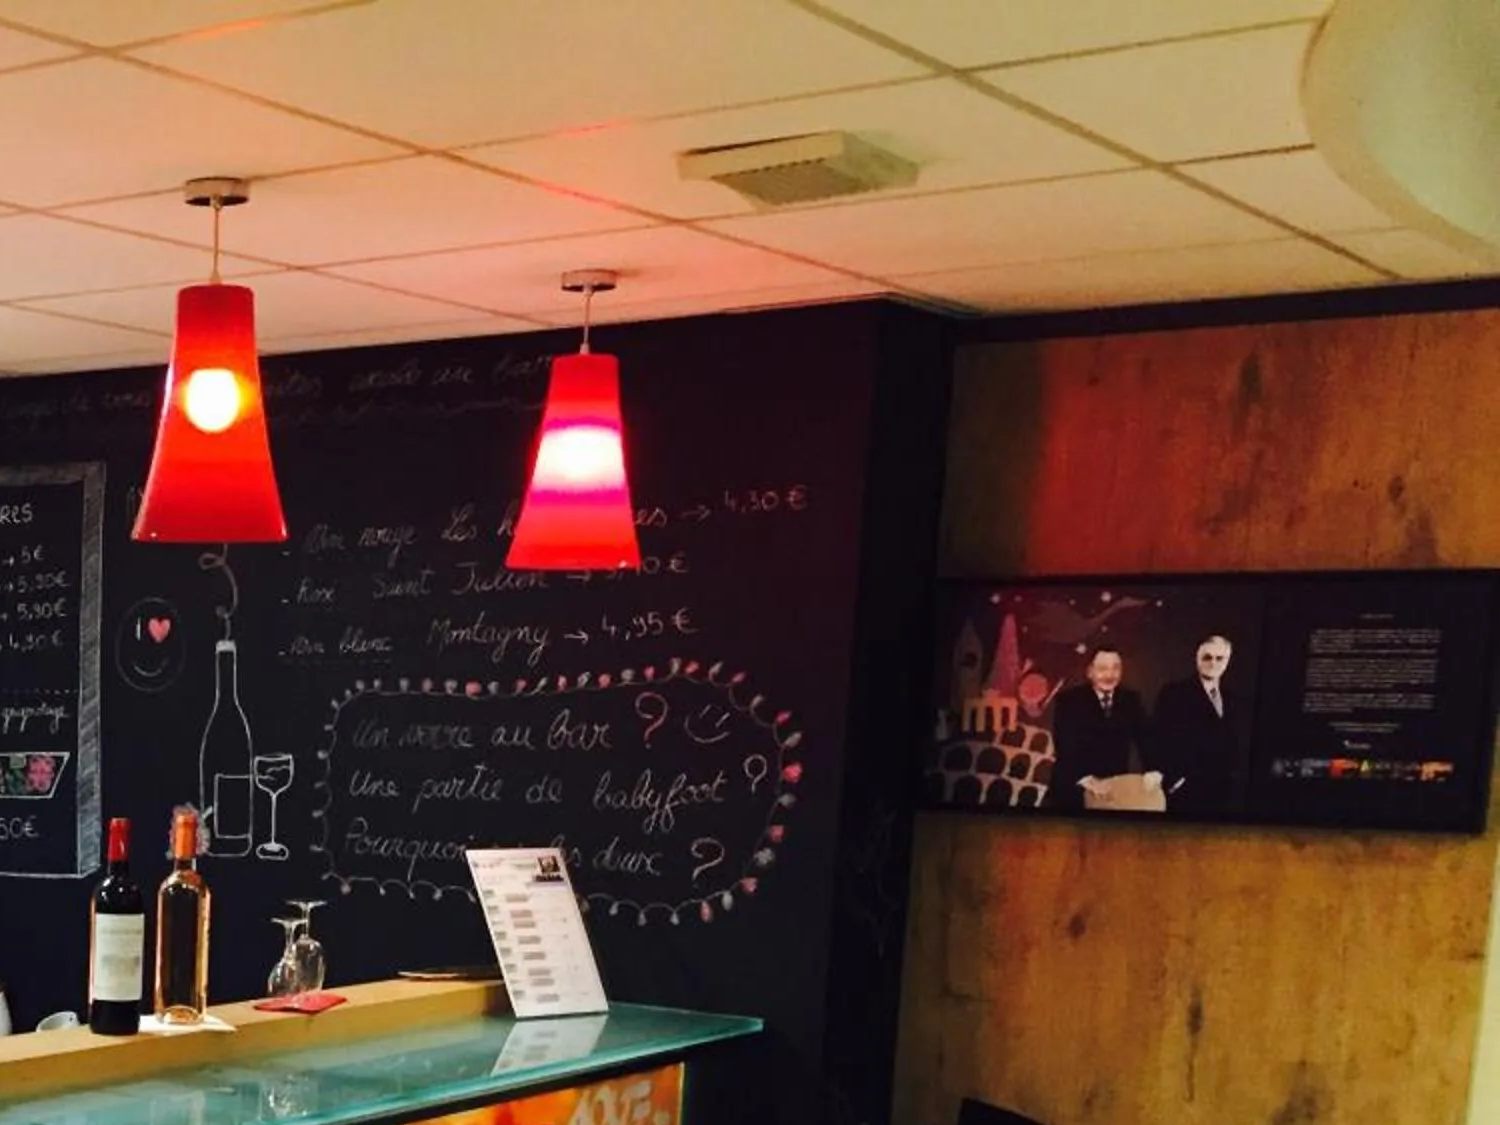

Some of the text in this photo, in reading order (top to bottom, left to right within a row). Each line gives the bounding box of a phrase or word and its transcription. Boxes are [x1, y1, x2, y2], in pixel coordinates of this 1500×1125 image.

[490, 727, 534, 750] au
[546, 708, 613, 750] bar
[348, 770, 401, 800] Une
